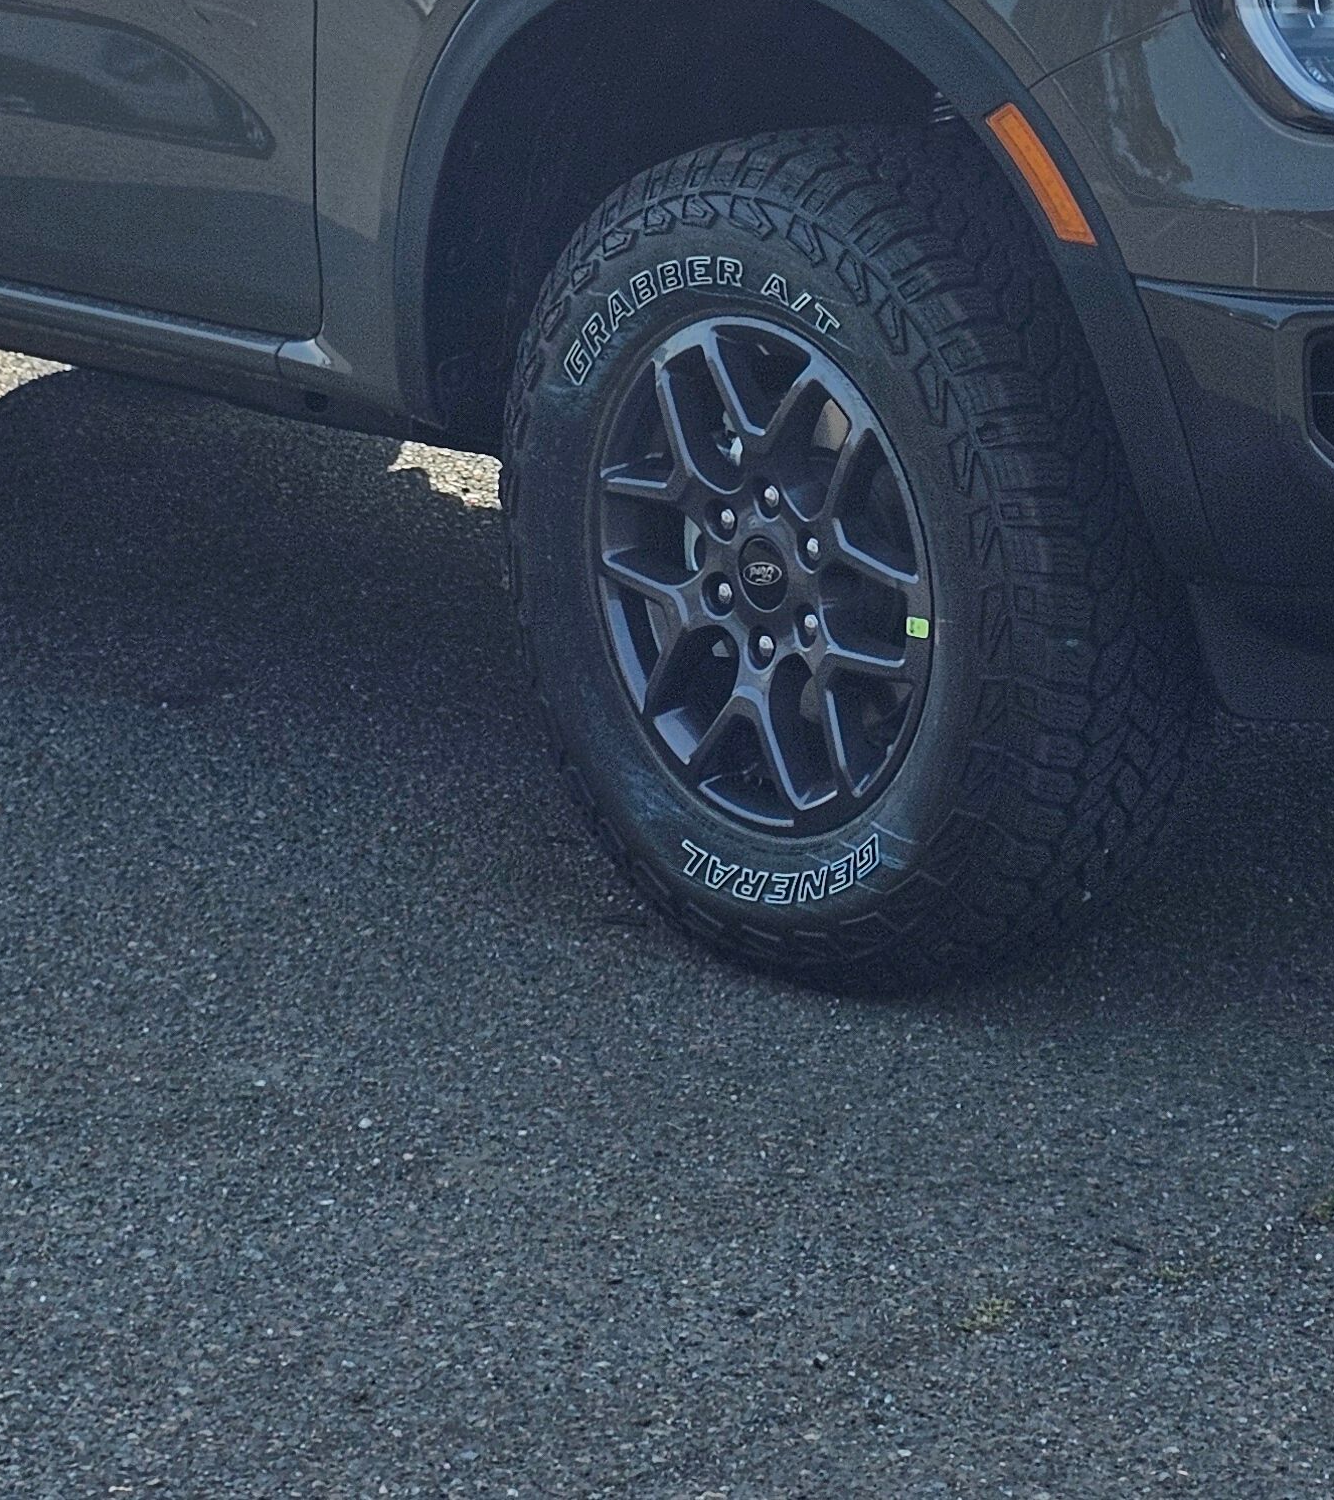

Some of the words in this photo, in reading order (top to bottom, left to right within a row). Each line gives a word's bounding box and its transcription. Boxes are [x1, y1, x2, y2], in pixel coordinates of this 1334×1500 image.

[563, 255, 743, 387] GRABBER
[760, 273, 841, 335] A/T
[681, 832, 881, 905] GENERAL
